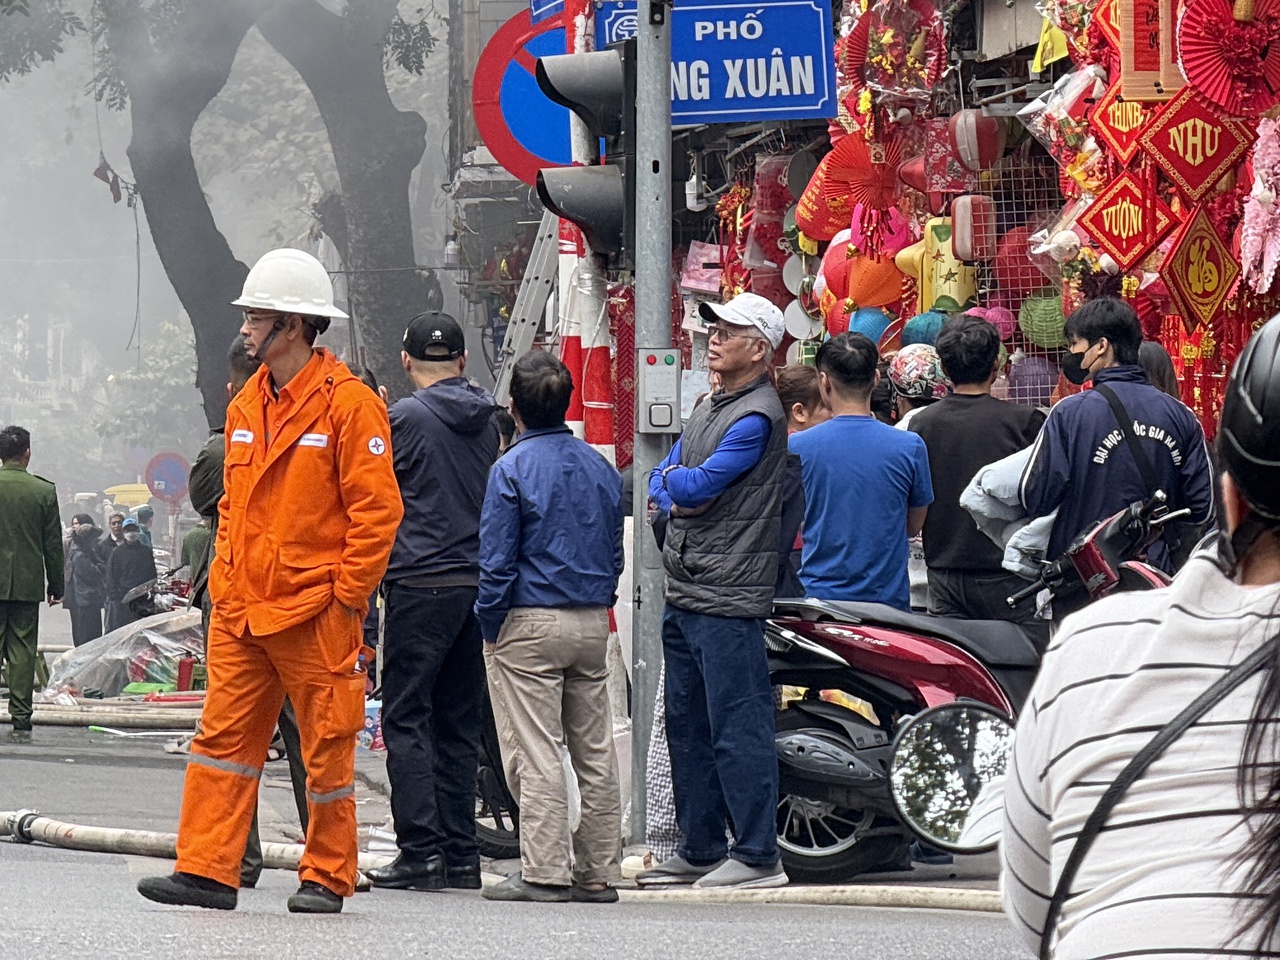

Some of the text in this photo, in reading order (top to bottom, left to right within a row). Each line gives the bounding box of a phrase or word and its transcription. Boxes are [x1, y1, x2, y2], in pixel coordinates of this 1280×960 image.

[695, 9, 764, 41] PHỐ
[671, 47, 815, 101] NG XUÂN
[1168, 117, 1222, 167] NHƯ
[1102, 429, 1122, 449] HỌC
[1148, 426, 1165, 441] GIA
